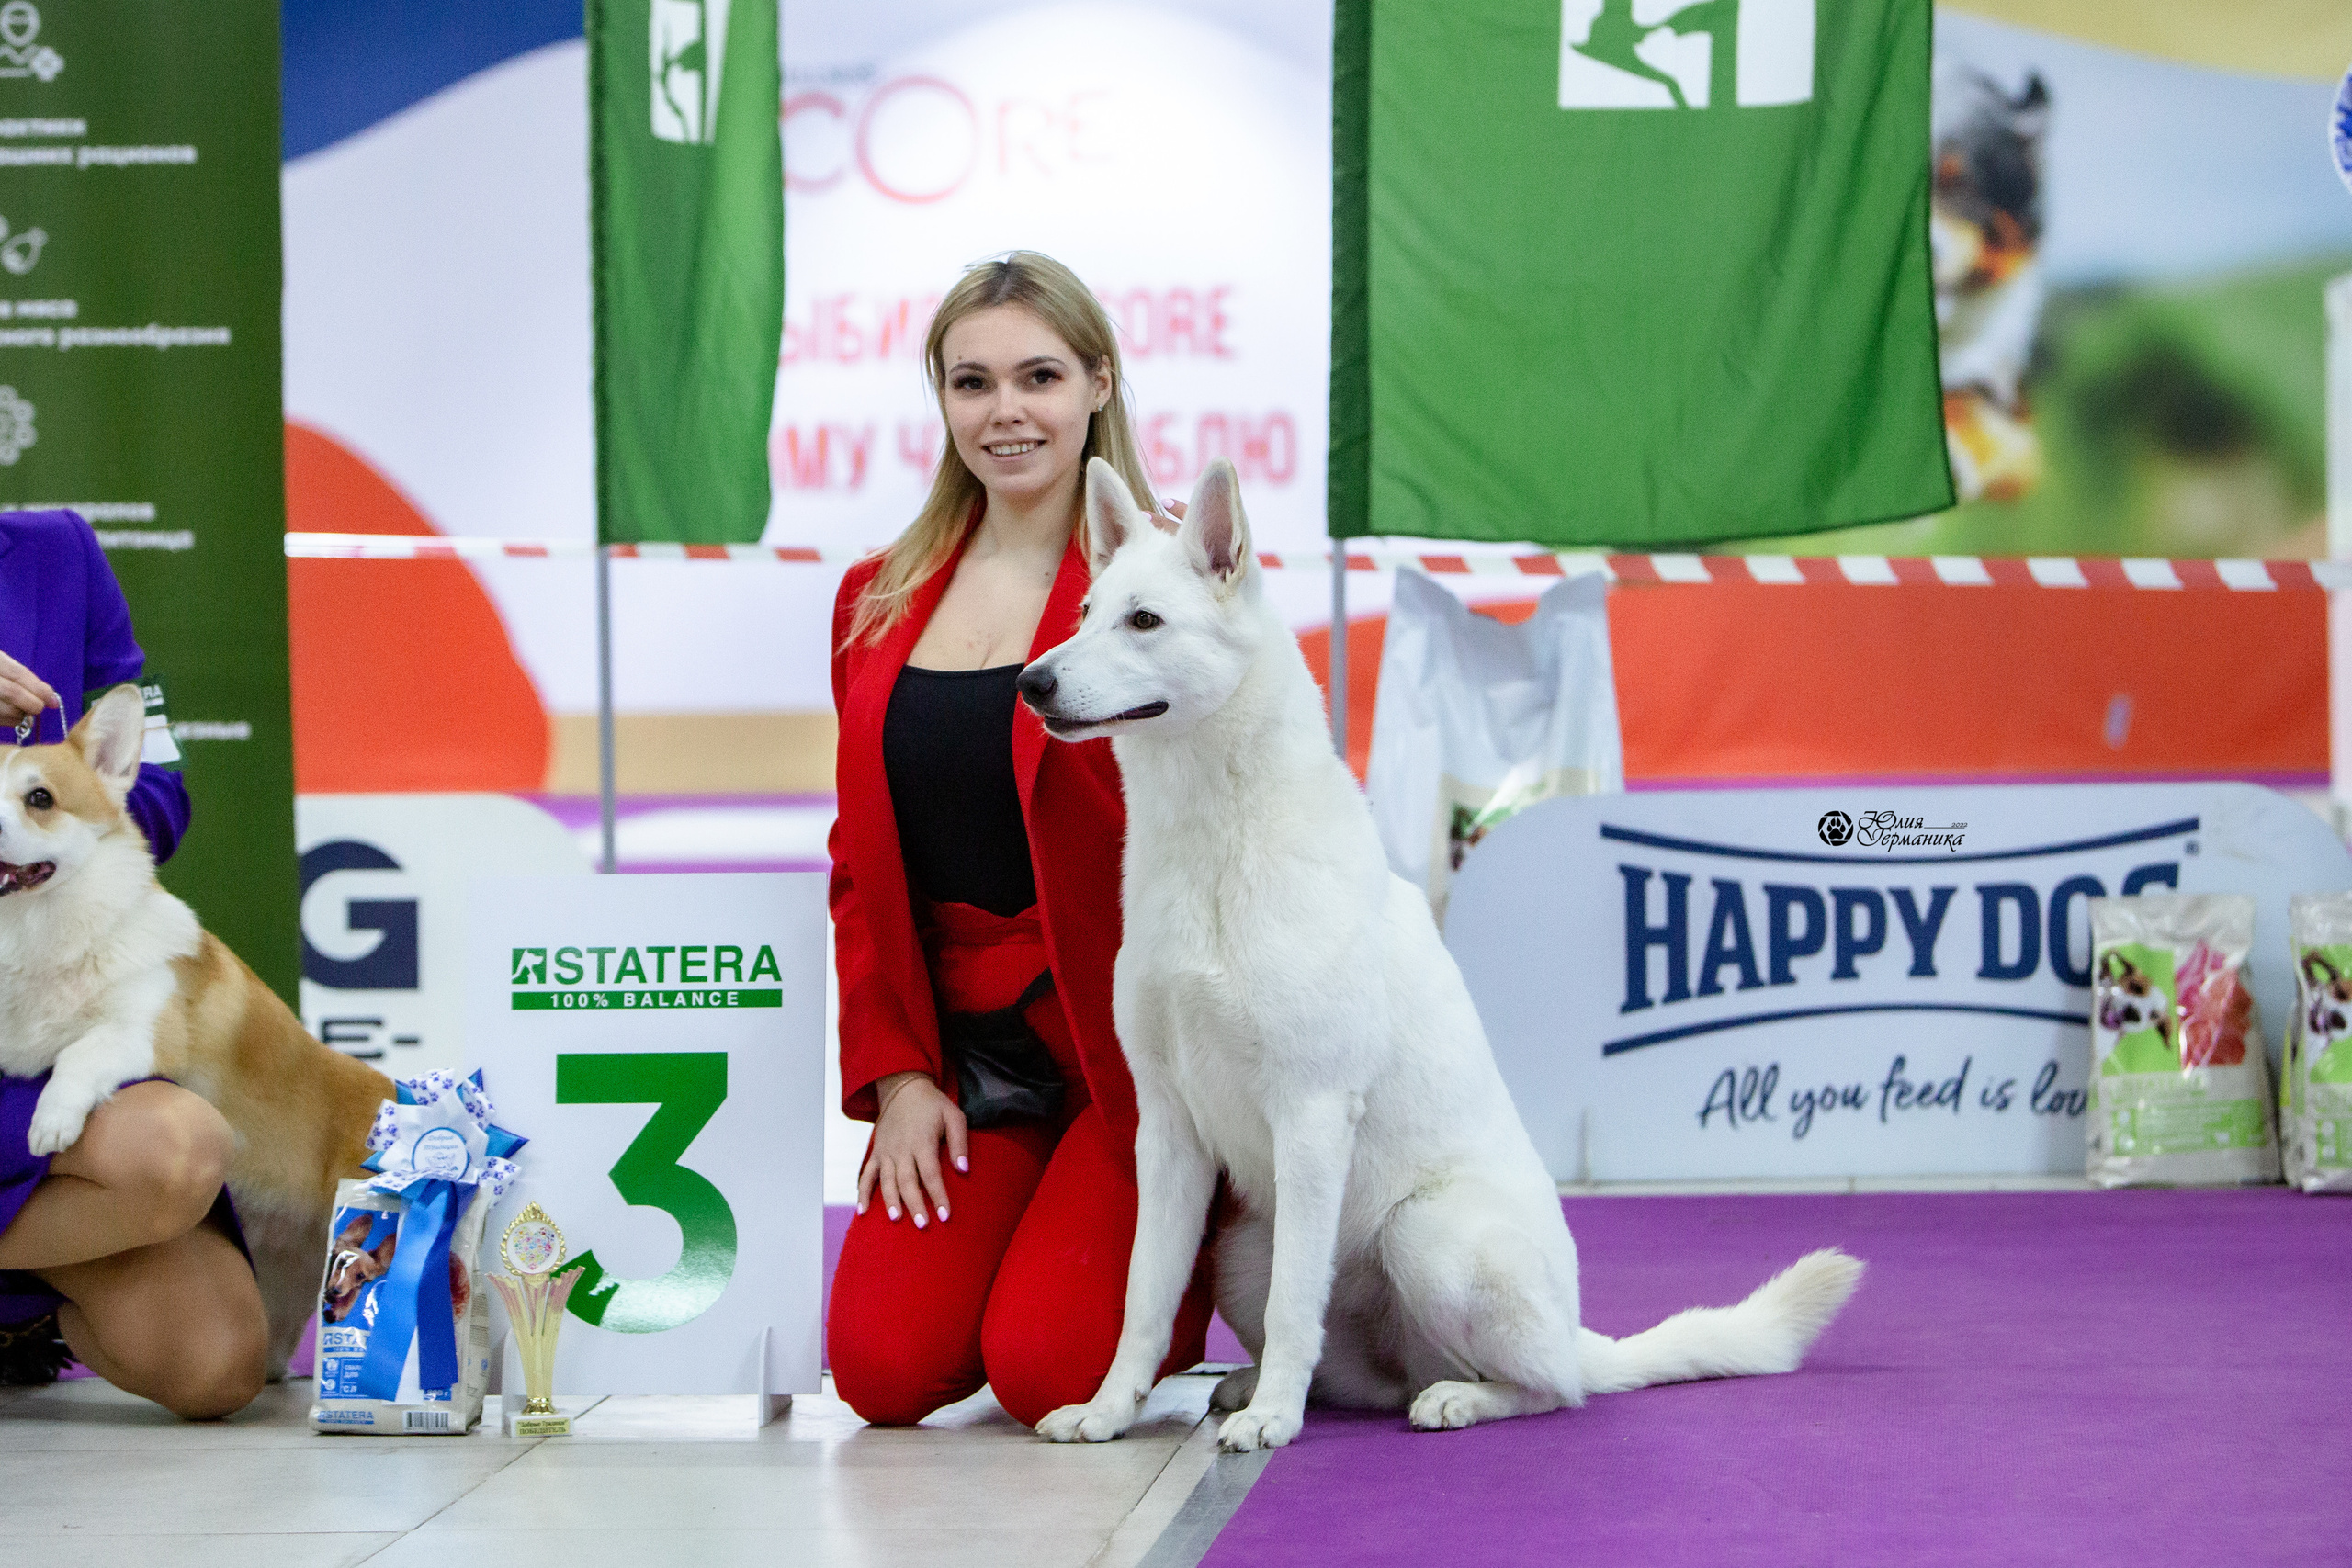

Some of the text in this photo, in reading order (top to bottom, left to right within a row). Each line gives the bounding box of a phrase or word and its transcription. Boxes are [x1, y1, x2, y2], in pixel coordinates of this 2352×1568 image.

[553, 945, 783, 986] STATERA
[1617, 863, 1959, 1016] HAPPY
[550, 991, 739, 1008] 100% BALANCE
[1696, 1053, 2089, 1140] All you feed is lov
[556, 1052, 737, 1334] 3
